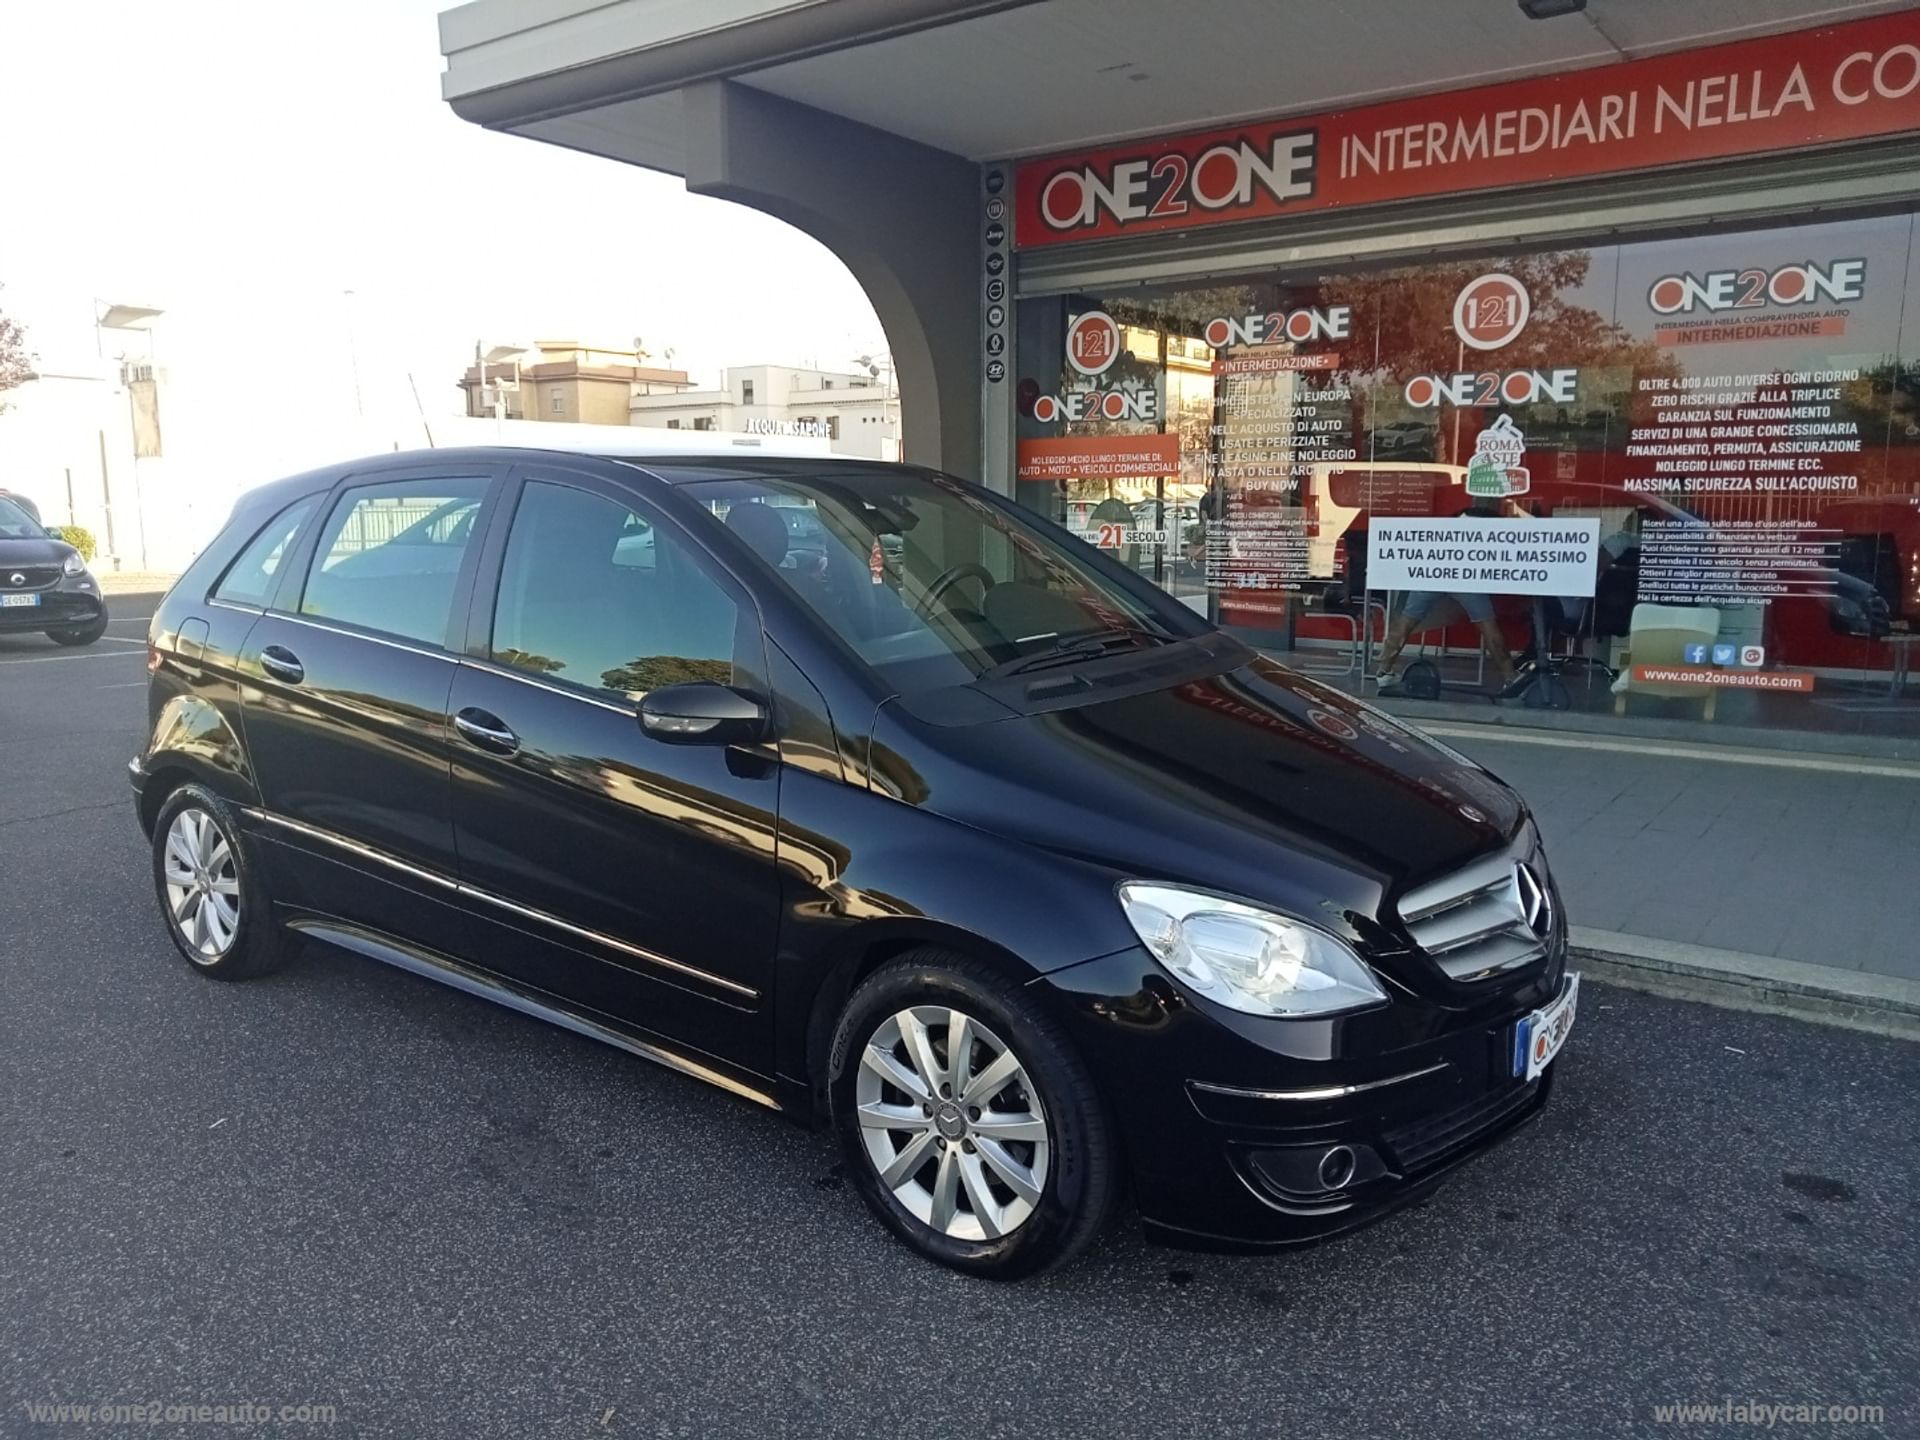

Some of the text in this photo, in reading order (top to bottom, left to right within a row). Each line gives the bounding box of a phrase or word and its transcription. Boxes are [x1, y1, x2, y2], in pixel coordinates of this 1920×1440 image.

[1041, 133, 1314, 229] ONE2ONE
[1339, 90, 1639, 179] INTERMEDIARI
[1654, 61, 1815, 134] NELLA
[1650, 261, 1864, 313] ONE2ONE
[1714, 317, 1741, 327] NELLA
[1743, 311, 1821, 325] COMPRAVENDITA
[1823, 308, 1850, 318] AUTO
[1205, 307, 1350, 348] ONE2ONE
[1677, 321, 1821, 344] INTERMEDIAZIONE
[1225, 355, 1323, 372] INTERMEDIAZIONE
[1405, 368, 1577, 408] ONE2ONE
[1639, 369, 1860, 391] OLTRE 4.000 AUTO DIVERSE OGNI GIORNO
[1304, 390, 1352, 402] EUROPA
[1651, 387, 1841, 407] ZERO RISCHI GRAZIE ALLA TRIPLICE
[1034, 390, 1155, 423] ONE2ONE
[1233, 406, 1317, 421] SPECIALIZZATO
[1658, 405, 1831, 423] GARANZIA SUL FUNZIONAMENTO
[1239, 421, 1295, 434] ACQUISTO
[1297, 421, 1309, 432] DI
[1310, 419, 1342, 432] AUTO
[1631, 421, 1858, 440] SERVIZI DI UNA GRANDE CONCESSIONARIA
[1219, 435, 1329, 449] USATE E PERIZZIATE
[1478, 439, 1523, 452] ROMA
[1626, 439, 1862, 457] FINANZIAMENTO, PERMUTA, ASSICURAZIONE
[1221, 451, 1271, 463] LEASING
[1270, 450, 1296, 462] FINE
[1298, 448, 1357, 461] NOLEGGIO
[1481, 452, 1518, 465] ASTE
[1018, 462, 1177, 475] AUTO MOTO VEICOLI COMMERCIALI
[1217, 466, 1244, 478] ASTA
[1247, 466, 1256, 476] O
[1258, 465, 1289, 477] NELL'
[1655, 457, 1824, 473] NOLEGGIO LUNGO TERMINE ECC.
[1246, 479, 1299, 491] BUY NOW
[1624, 475, 1858, 492] MASSIMA SICUREZZA SULL'ACQUISTO
[1125, 531, 1166, 543] SECOLO
[1378, 530, 1590, 545] IN ALTERNATIVA ACQUISTIAMO
[1378, 548, 1587, 564] LA TUA AUTO CON IL MASSIMO
[1792, 546, 1802, 554] 12
[1408, 566, 1549, 582] VALORE DI MERCATO
[1644, 669, 1802, 688] www.one2oneauto.com
